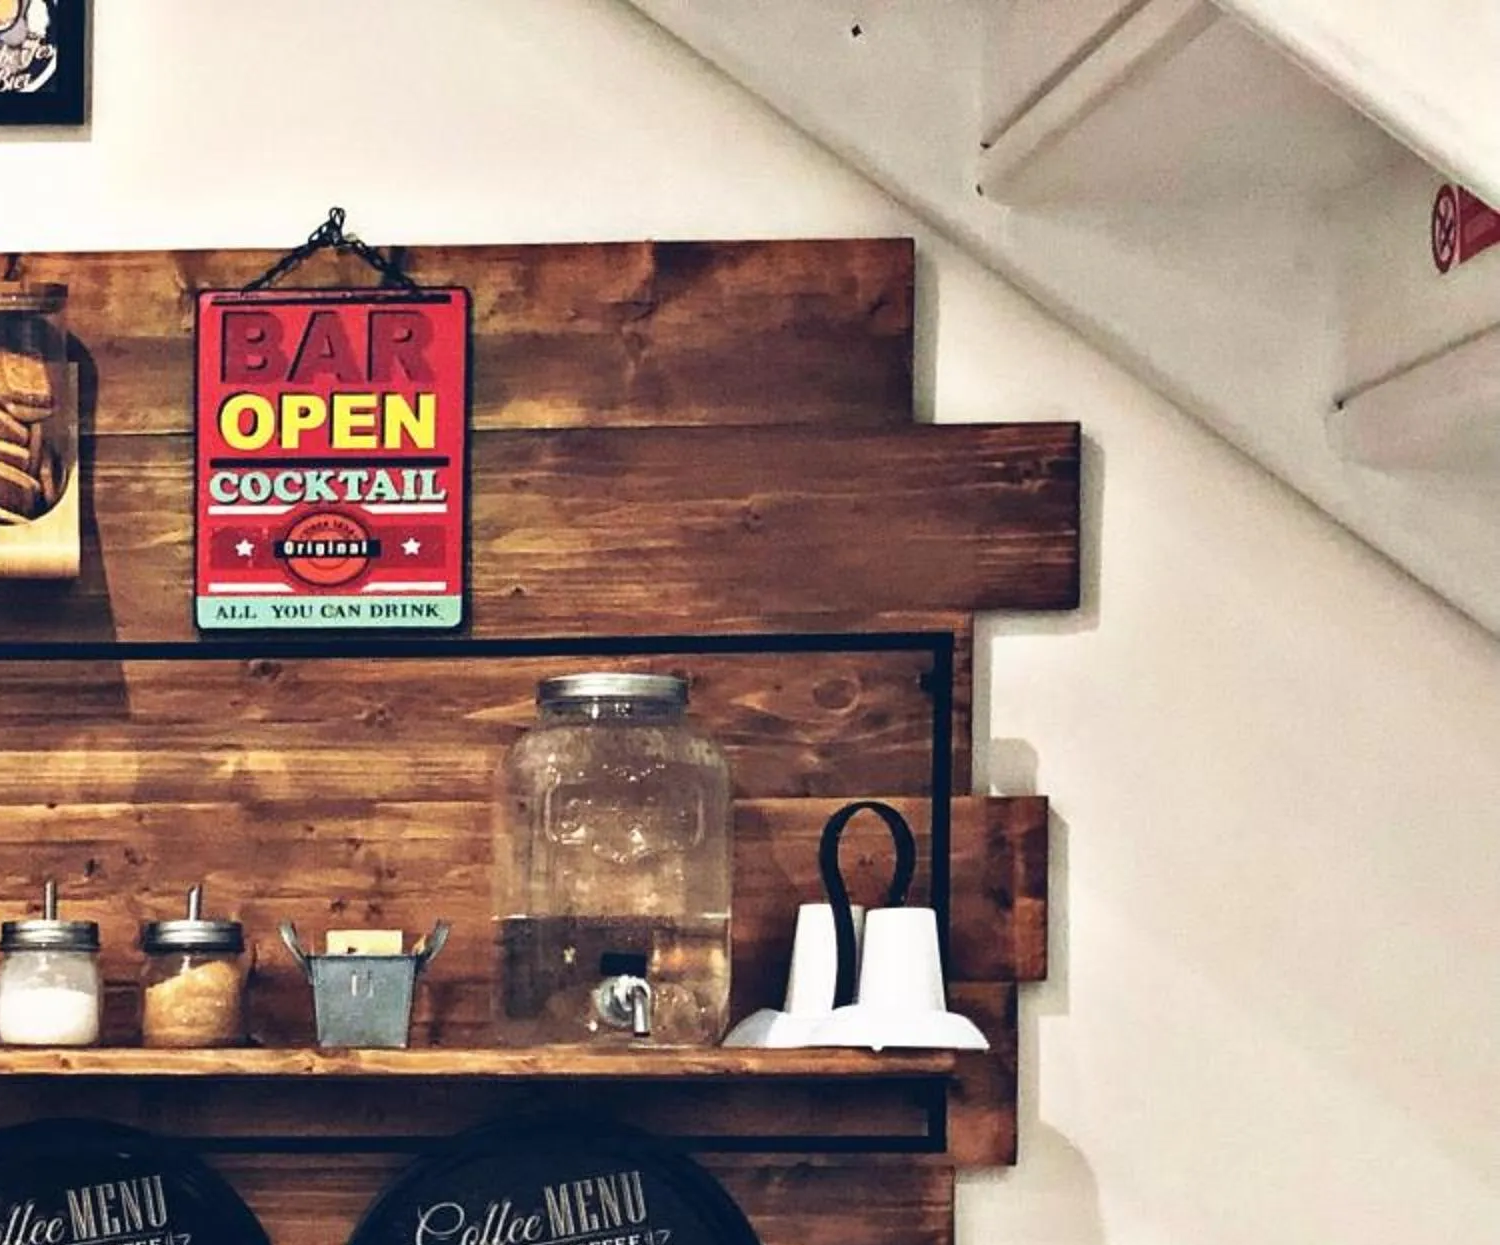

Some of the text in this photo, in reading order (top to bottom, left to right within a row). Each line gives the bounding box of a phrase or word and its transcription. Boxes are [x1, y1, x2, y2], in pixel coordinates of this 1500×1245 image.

[220, 310, 436, 384] BAR
[218, 391, 437, 450] OPEN
[209, 468, 448, 505] COCKTAIL
[283, 540, 368, 556] Original
[216, 603, 440, 619] ALL YOU CAN DRINK
[66, 1175, 167, 1241] MENU
[544, 1170, 647, 1238] MENU
